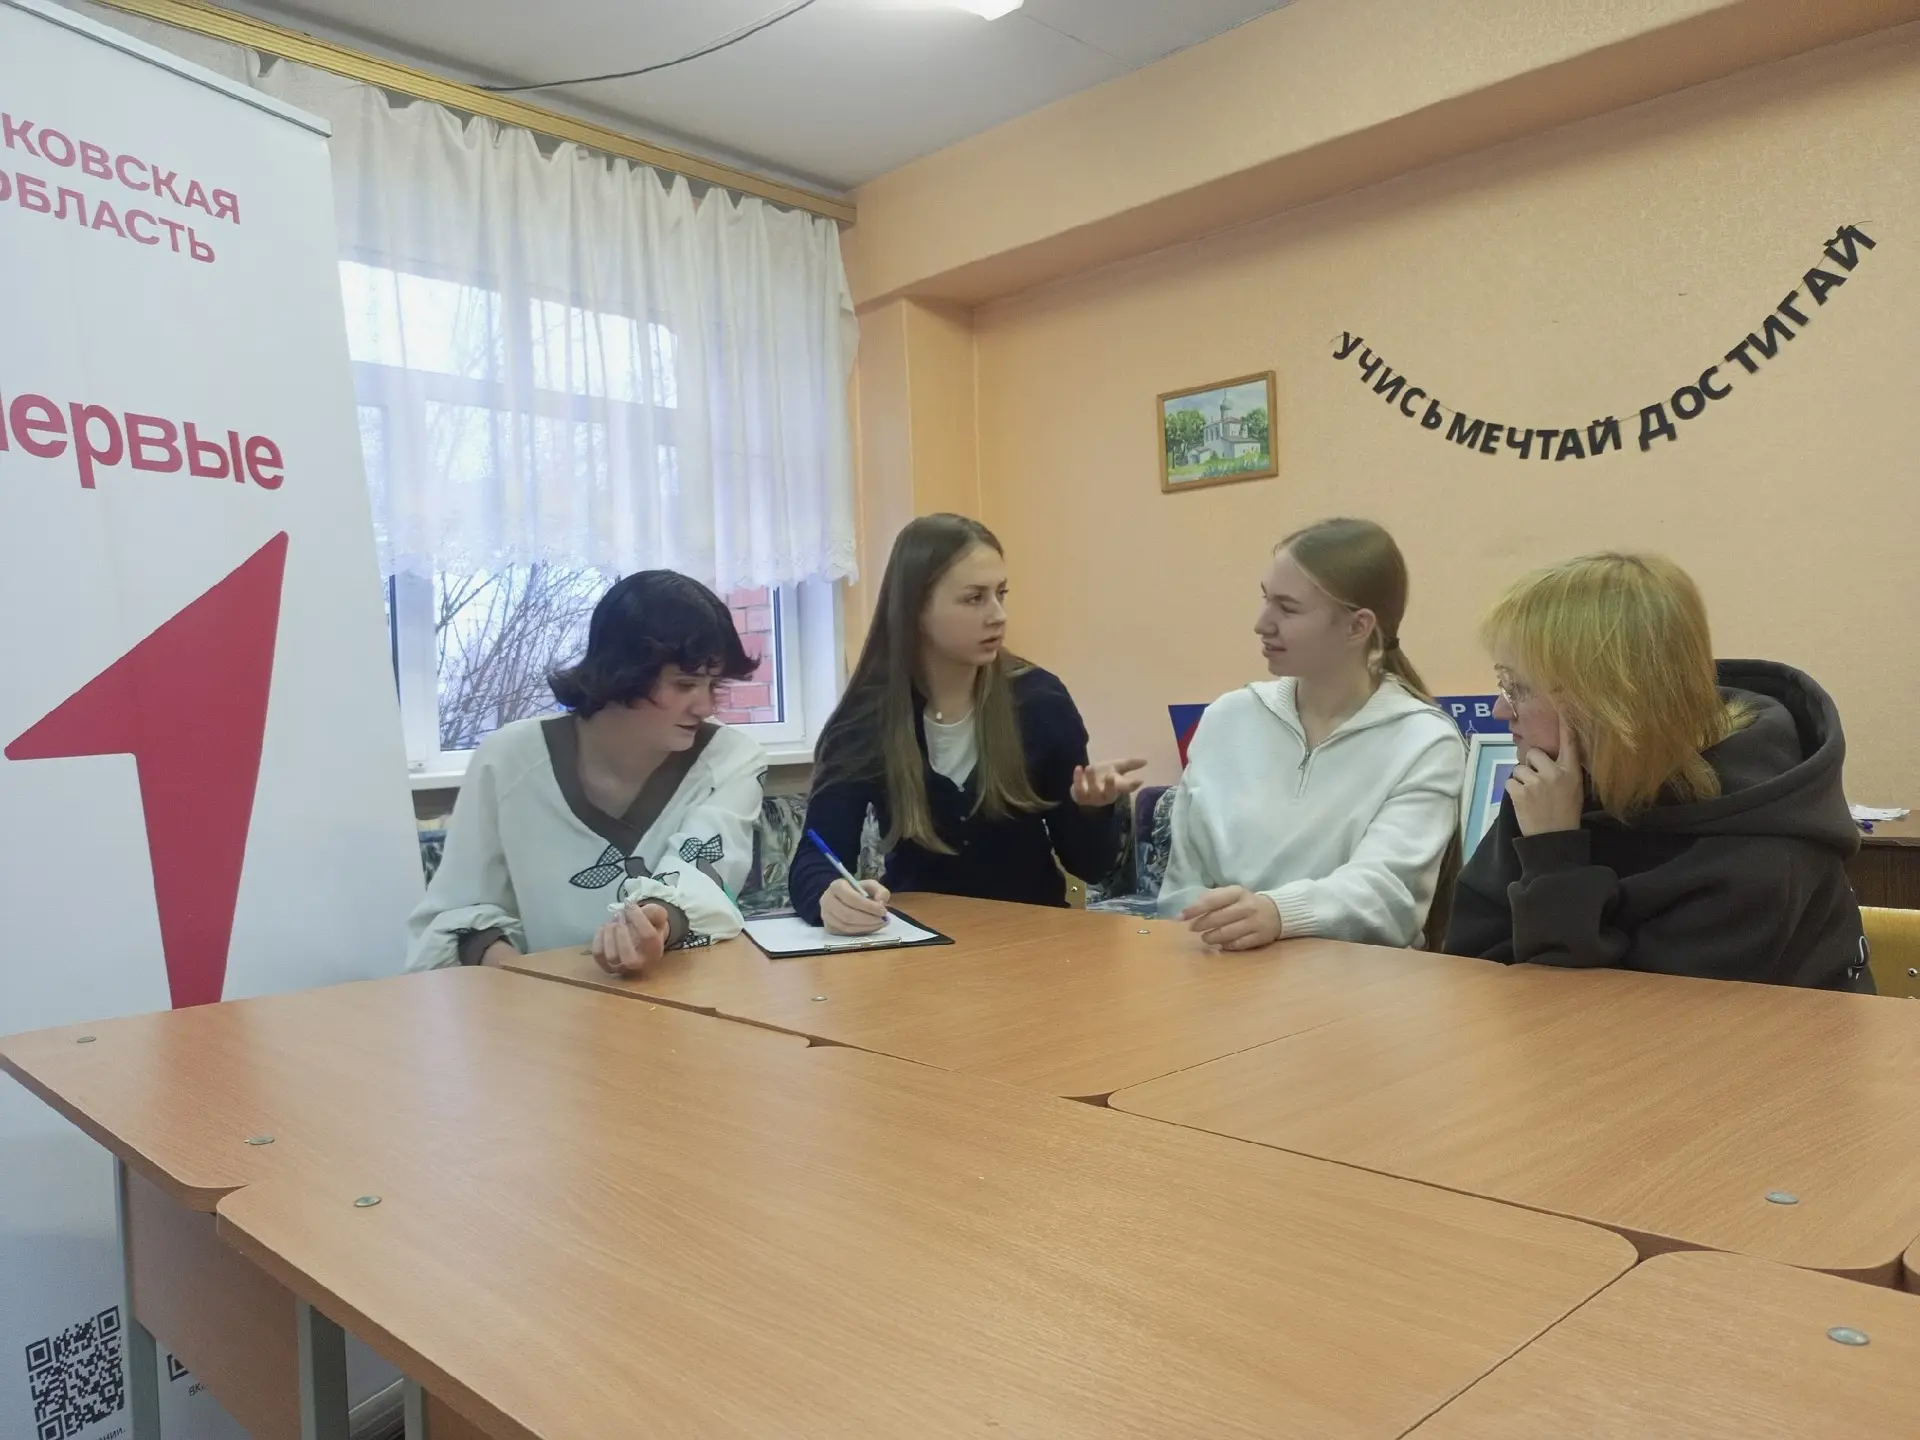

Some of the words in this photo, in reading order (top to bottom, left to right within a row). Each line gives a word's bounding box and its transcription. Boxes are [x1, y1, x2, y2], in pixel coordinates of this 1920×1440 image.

[1, 112, 241, 225] КОВСКАЯ
[0, 386, 285, 490] ервые
[1332, 331, 1444, 430] УЧИСЬ
[1446, 415, 1622, 461] МЕЧТАЙ
